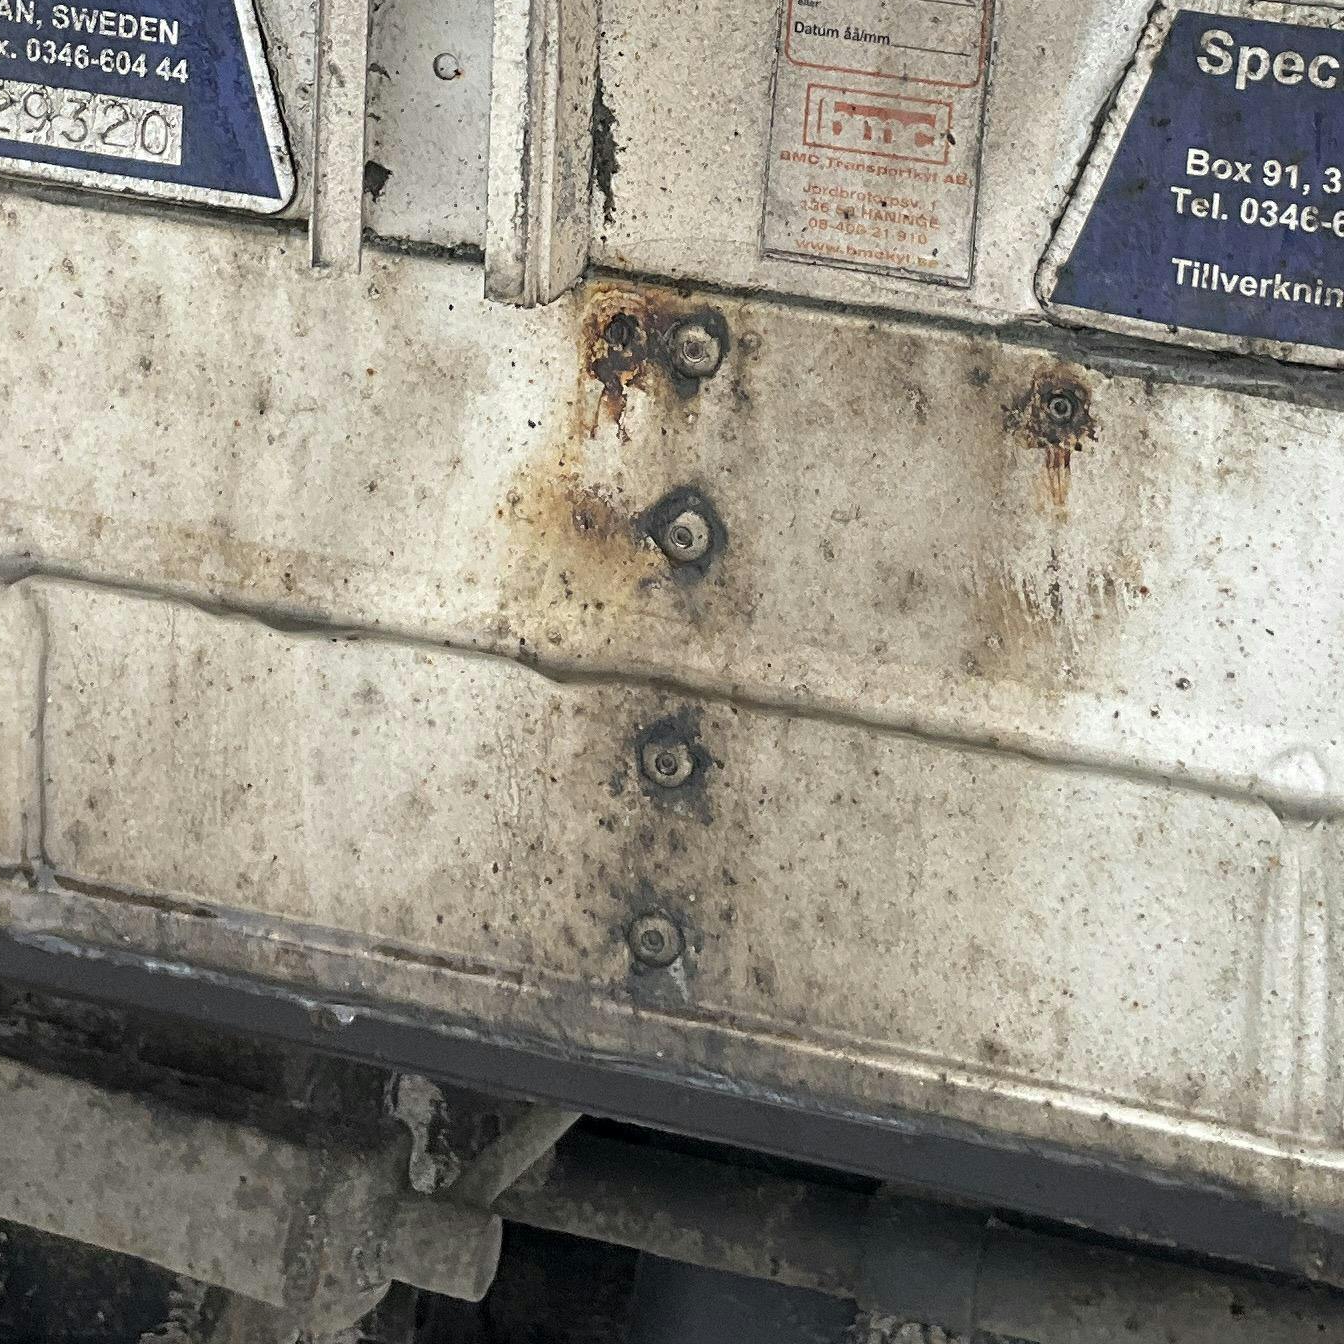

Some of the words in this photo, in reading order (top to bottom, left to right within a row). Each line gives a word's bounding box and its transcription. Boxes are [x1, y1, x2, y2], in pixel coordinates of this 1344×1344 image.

[52, 4, 180, 46] SWEDEN
[794, 21, 839, 39] Datum
[843, 26, 891, 45] åå/mm
[25, 37, 149, 79] 0346-604
[155, 56, 189, 84] 44
[779, 150, 820, 165] BMC
[1185, 147, 1253, 185] Box
[1262, 159, 1311, 196] 91,
[1170, 185, 1229, 220] Tel.
